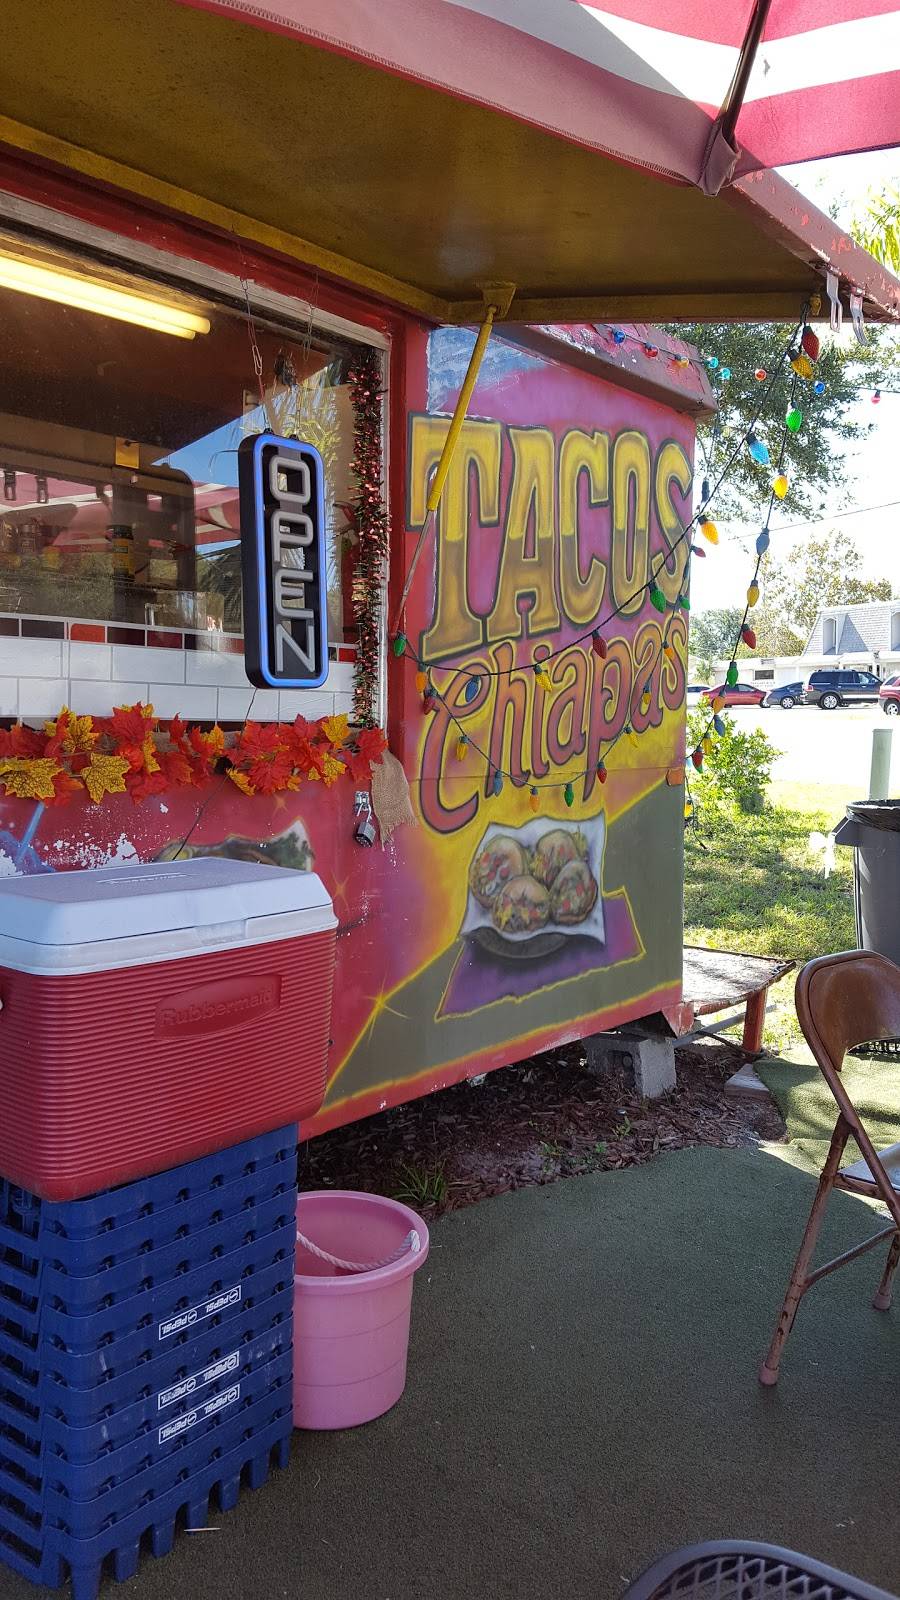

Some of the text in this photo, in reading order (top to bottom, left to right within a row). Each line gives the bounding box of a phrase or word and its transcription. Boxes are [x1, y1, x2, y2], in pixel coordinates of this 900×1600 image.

[269, 456, 316, 672] OPEN
[408, 412, 692, 661] TACOS
[420, 611, 688, 833] Chiapas
[160, 984, 274, 1027] Rubbermaid
[162, 1294, 229, 1335] PEPSI PEPSI
